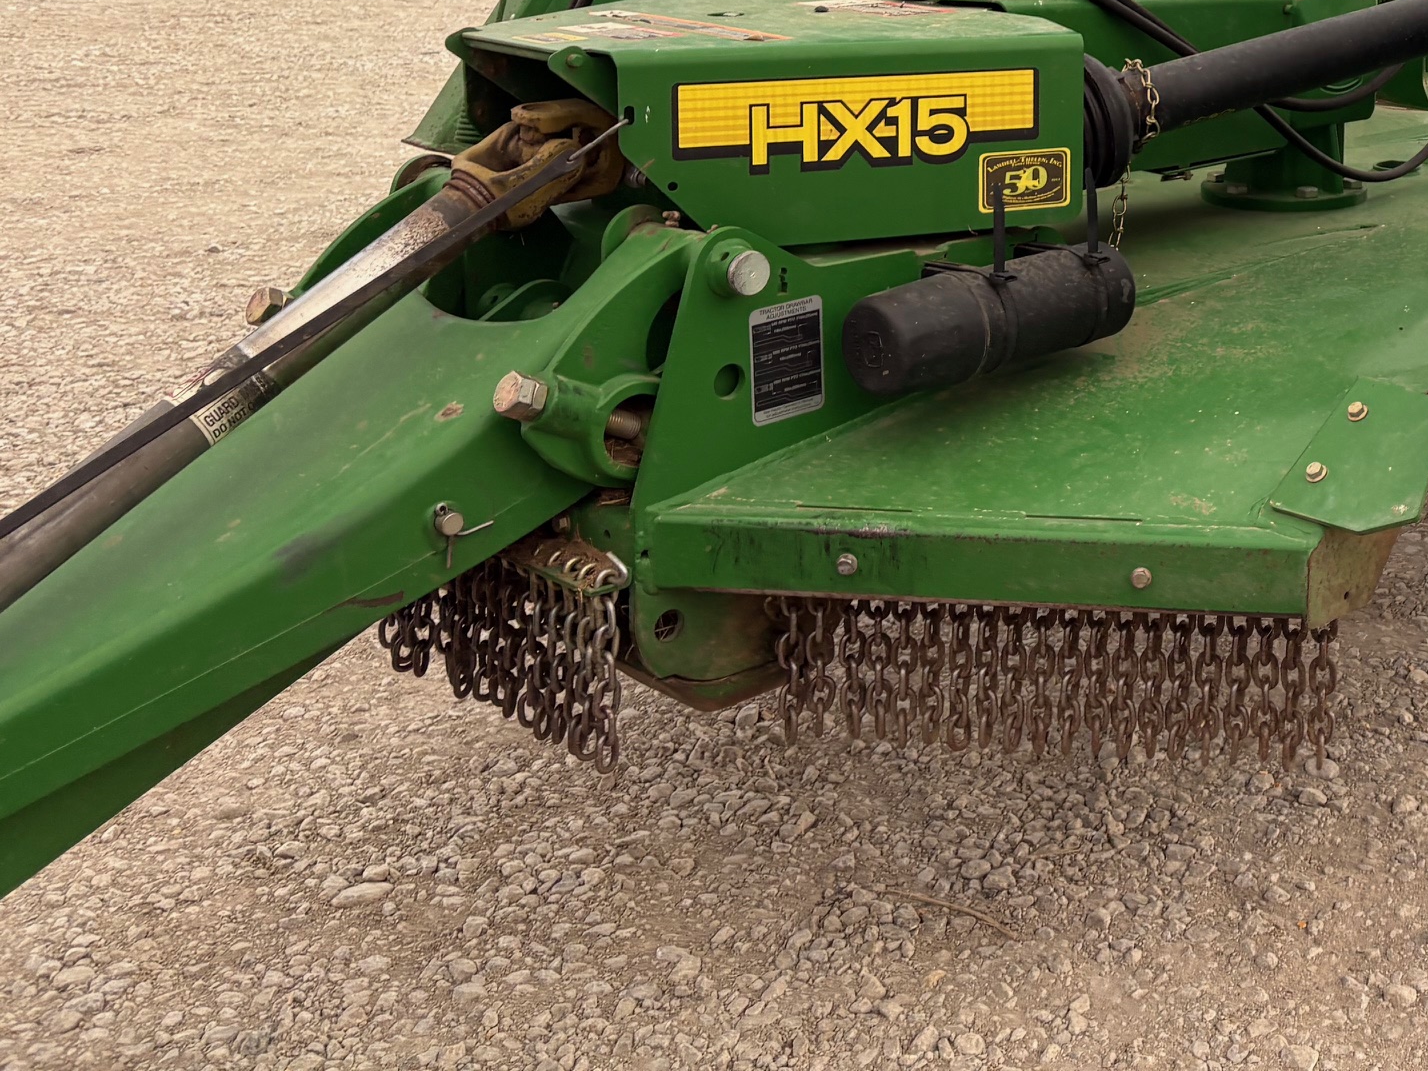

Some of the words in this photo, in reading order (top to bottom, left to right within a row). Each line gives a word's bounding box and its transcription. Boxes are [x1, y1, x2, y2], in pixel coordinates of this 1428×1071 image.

[750, 94, 970, 172] HX15
[1002, 165, 1048, 196] 50
[204, 396, 240, 427] GUARD
[213, 423, 228, 438] DO
[227, 406, 247, 427] NOT
